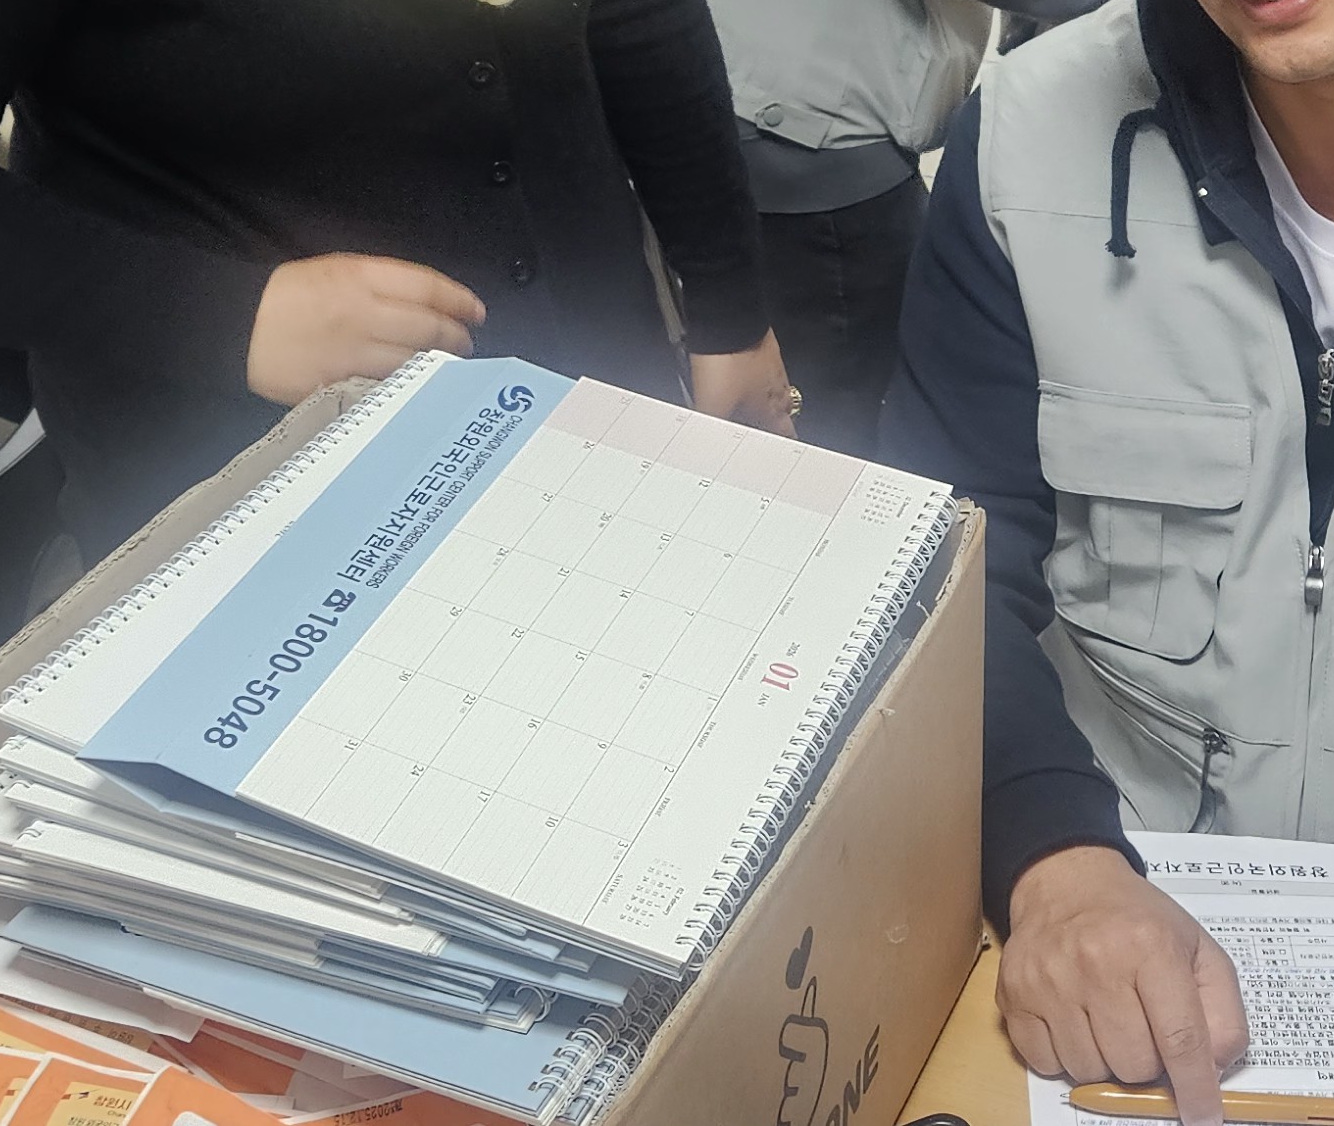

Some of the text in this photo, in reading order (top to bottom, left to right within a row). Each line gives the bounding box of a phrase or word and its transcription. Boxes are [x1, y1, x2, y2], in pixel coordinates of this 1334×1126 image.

[583, 441, 594, 450] 26
[640, 461, 652, 469] 19
[699, 479, 711, 488] 12
[365, 414, 523, 589] CHANGWON SUPPORT CENTER FOR FOREIGN WORKERS
[541, 493, 554, 502] 27
[600, 512, 612, 522] 20
[660, 533, 672, 542] 13
[496, 547, 509, 556] 28
[203, 407, 505, 749] 창원외국인근로자지원센터 1800-5048
[557, 568, 570, 577] 21
[619, 589, 631, 599] 14
[450, 606, 462, 617] 29
[511, 628, 524, 639] 22
[575, 651, 588, 661] 15
[398, 670, 411, 682] 30
[760, 662, 799, 691] 01
[462, 694, 476, 705] 23
[527, 718, 541, 729] 16
[344, 740, 357, 751] 31
[410, 765, 424, 776] 24
[477, 791, 490, 803] 17
[545, 817, 558, 828] 10
